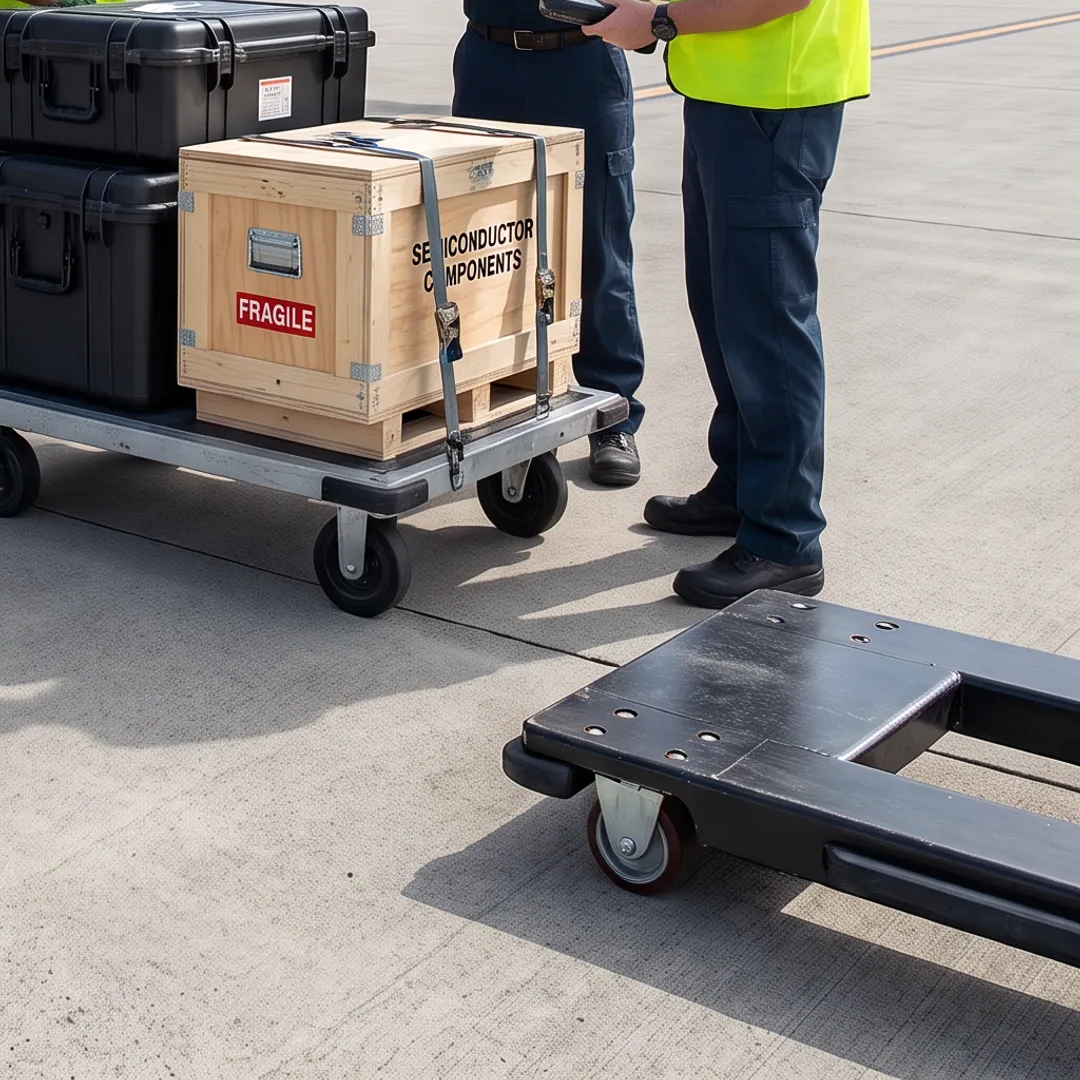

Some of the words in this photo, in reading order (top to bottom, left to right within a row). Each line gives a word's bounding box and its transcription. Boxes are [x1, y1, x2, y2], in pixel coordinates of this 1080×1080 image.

[412, 218, 534, 266] SEICONDUCTOR
[424, 248, 522, 293] CMPONENTS
[239, 298, 313, 332] FRAGILE
